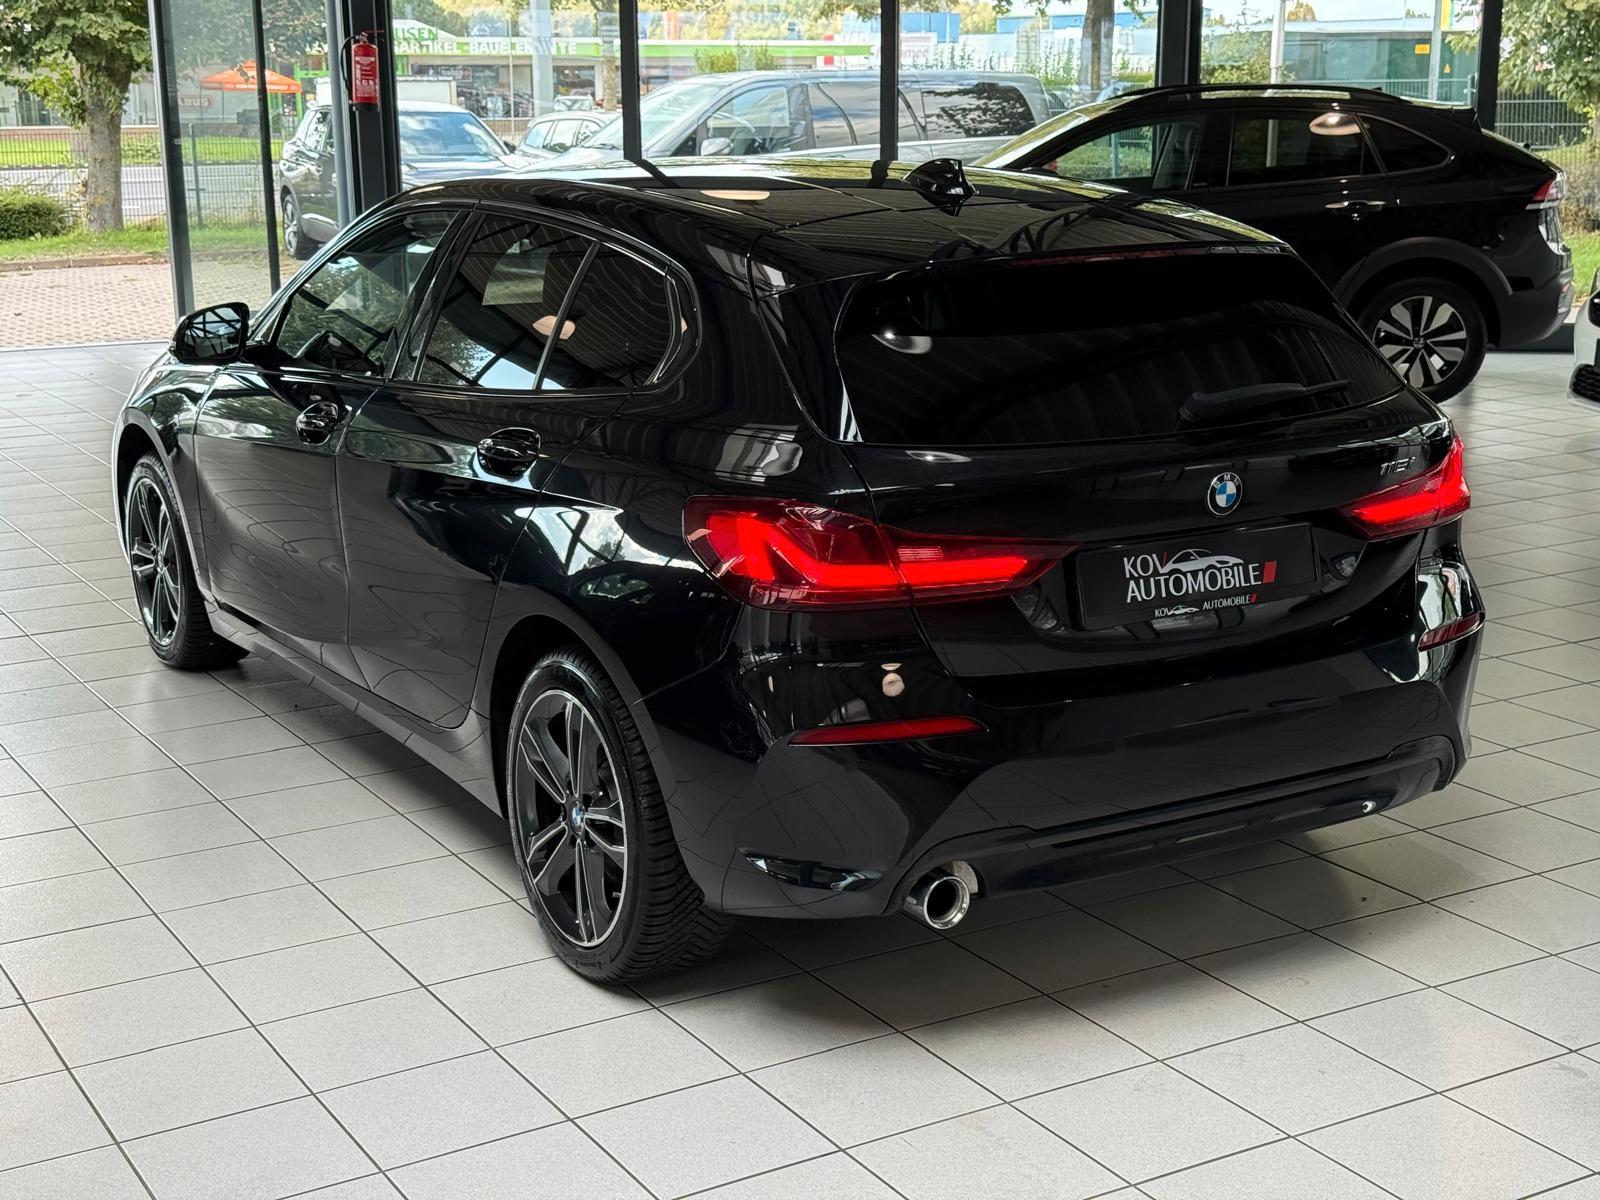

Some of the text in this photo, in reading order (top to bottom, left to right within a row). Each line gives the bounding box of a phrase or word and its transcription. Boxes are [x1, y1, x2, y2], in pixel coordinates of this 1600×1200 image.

[1123, 552, 1168, 578] KOV
[1126, 563, 1262, 603] AUTOMOBILE
[1202, 594, 1252, 611] AUTOMOBILE
